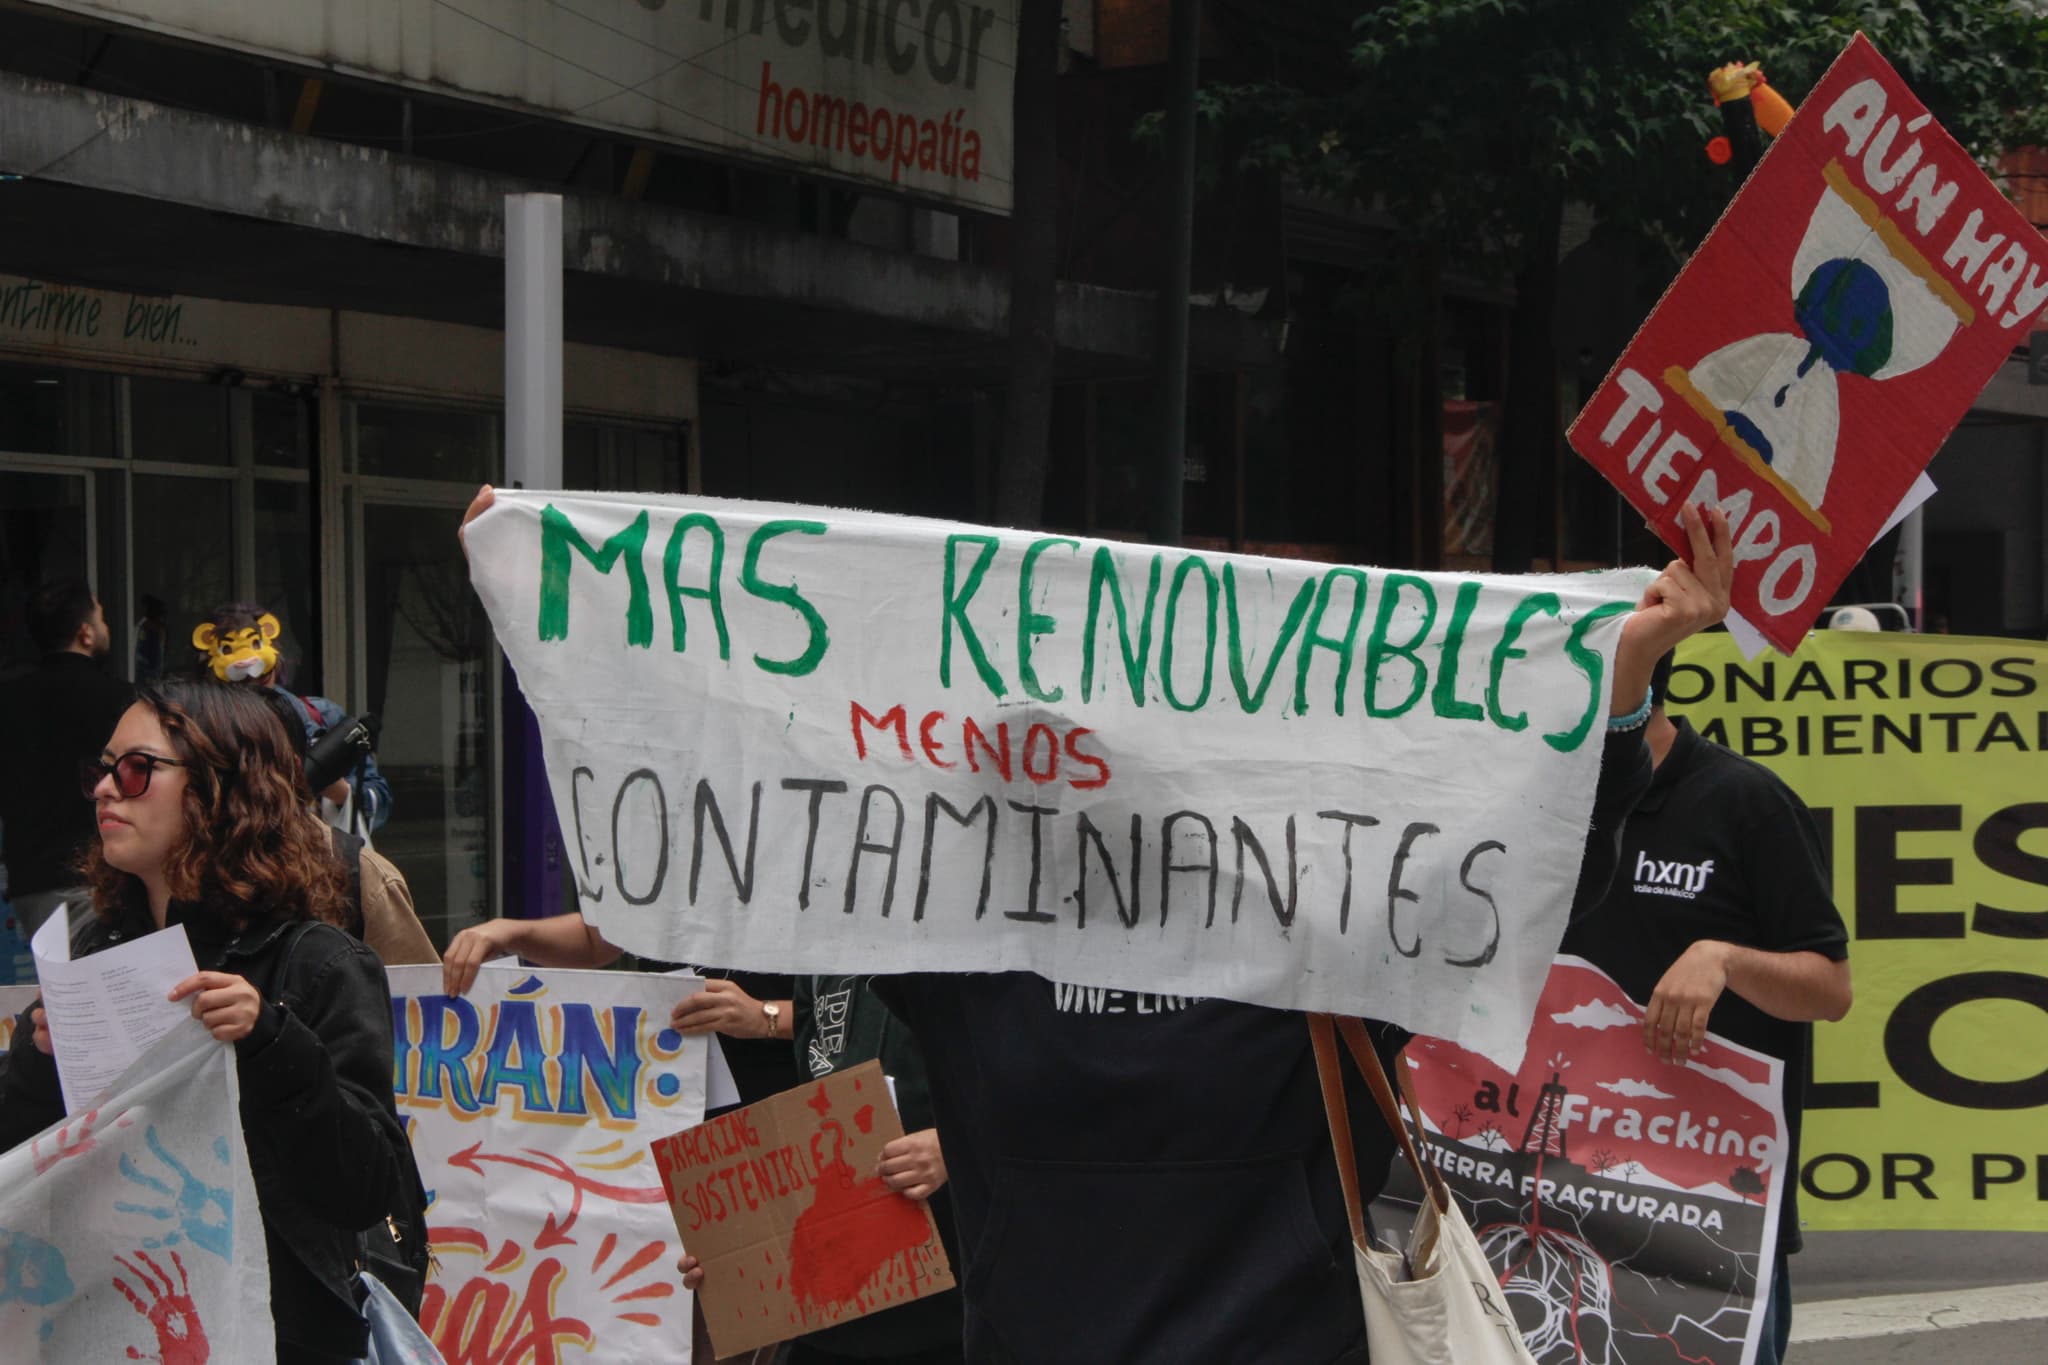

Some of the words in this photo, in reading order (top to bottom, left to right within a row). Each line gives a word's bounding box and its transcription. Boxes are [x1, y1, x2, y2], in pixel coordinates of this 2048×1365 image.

[756, 61, 981, 183] homeopatía
[1823, 78, 1960, 236] AÚN
[1943, 208, 2048, 329] HAY
[1600, 367, 1817, 616] TIEMPO
[538, 503, 831, 677] MAS
[939, 534, 1638, 752] RENOVABLES
[850, 699, 1112, 790] MENOS
[572, 766, 1507, 967] CONTAMINANTES
[651, 1107, 761, 1205] FRACKING
[1474, 1080, 1520, 1118] al
[1558, 1093, 1776, 1175] Fracking
[1520, 1175, 1724, 1231] FRACTURADA
